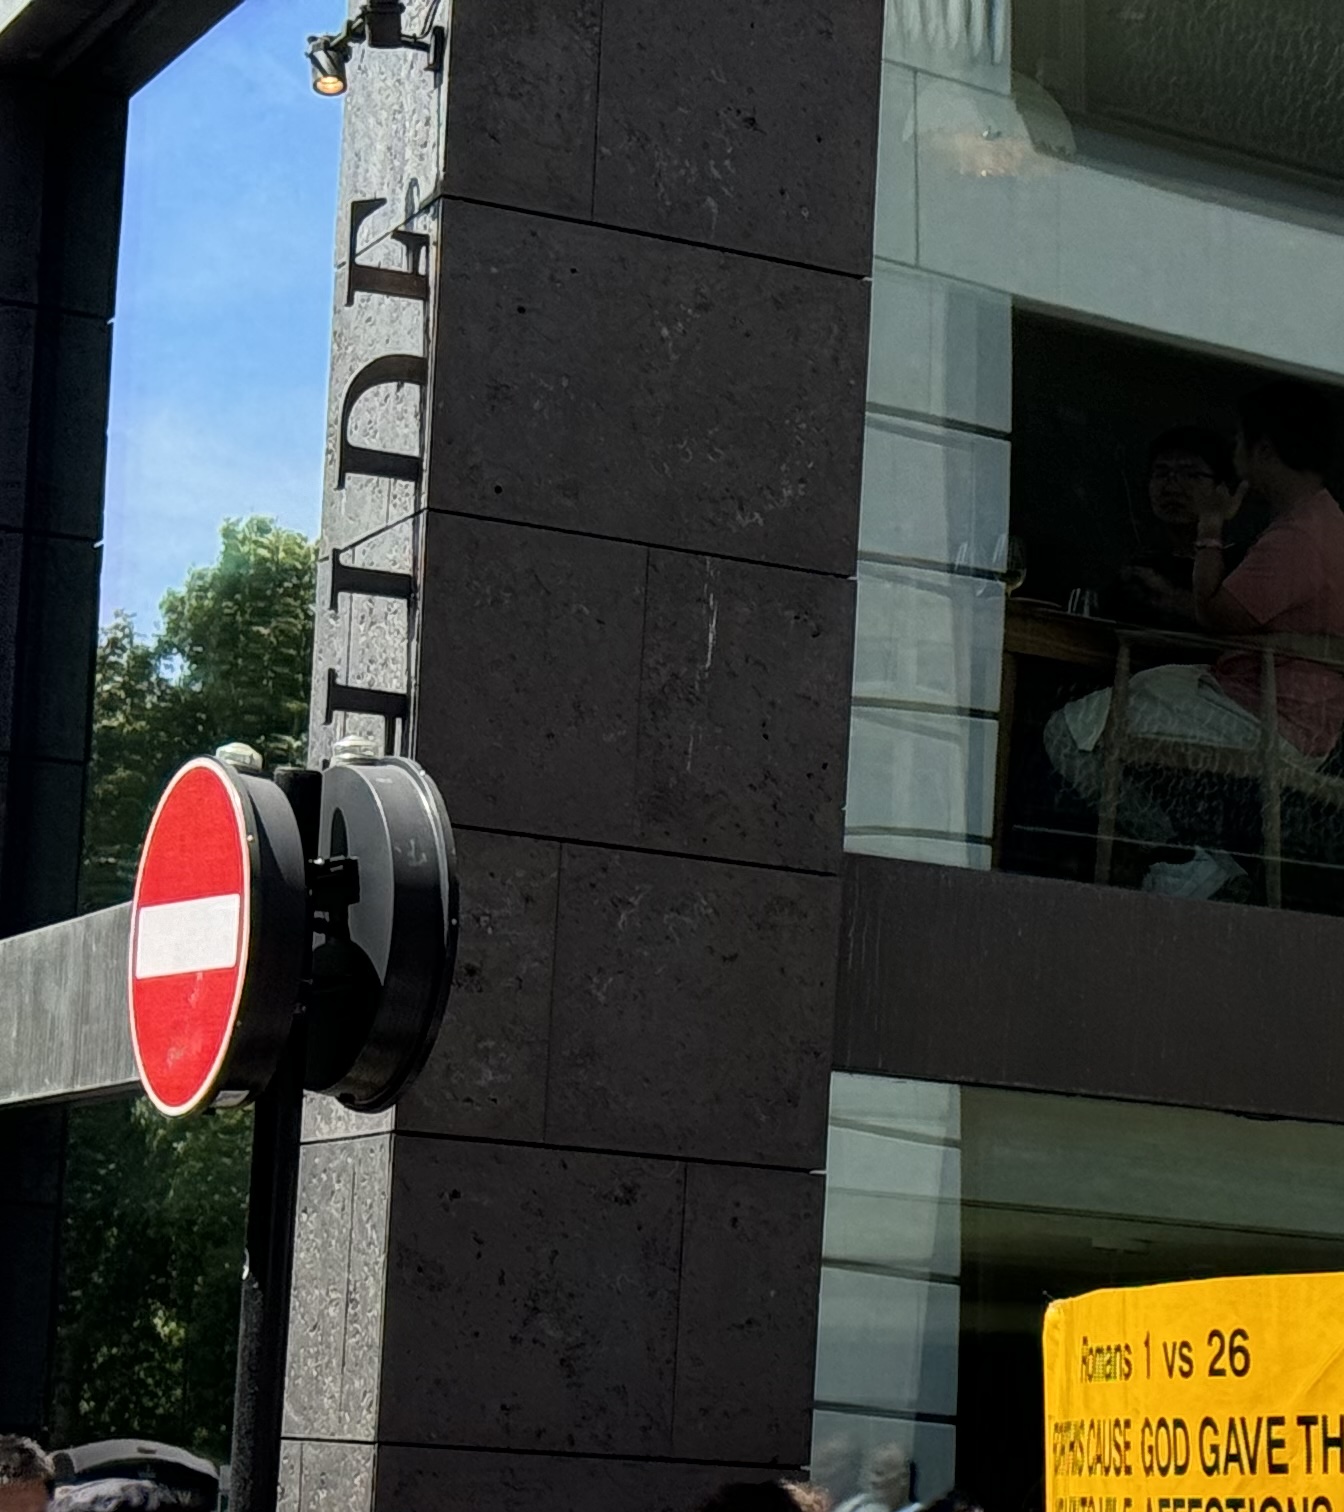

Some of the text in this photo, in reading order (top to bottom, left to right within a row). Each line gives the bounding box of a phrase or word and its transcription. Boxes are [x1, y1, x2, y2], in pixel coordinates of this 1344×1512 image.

[1080, 1328, 1251, 1383] Romans 1 vs 26
[1087, 1417, 1133, 1477] CAUSE
[1141, 1416, 1190, 1477] GOD
[1200, 1415, 1289, 1477] GAVE
